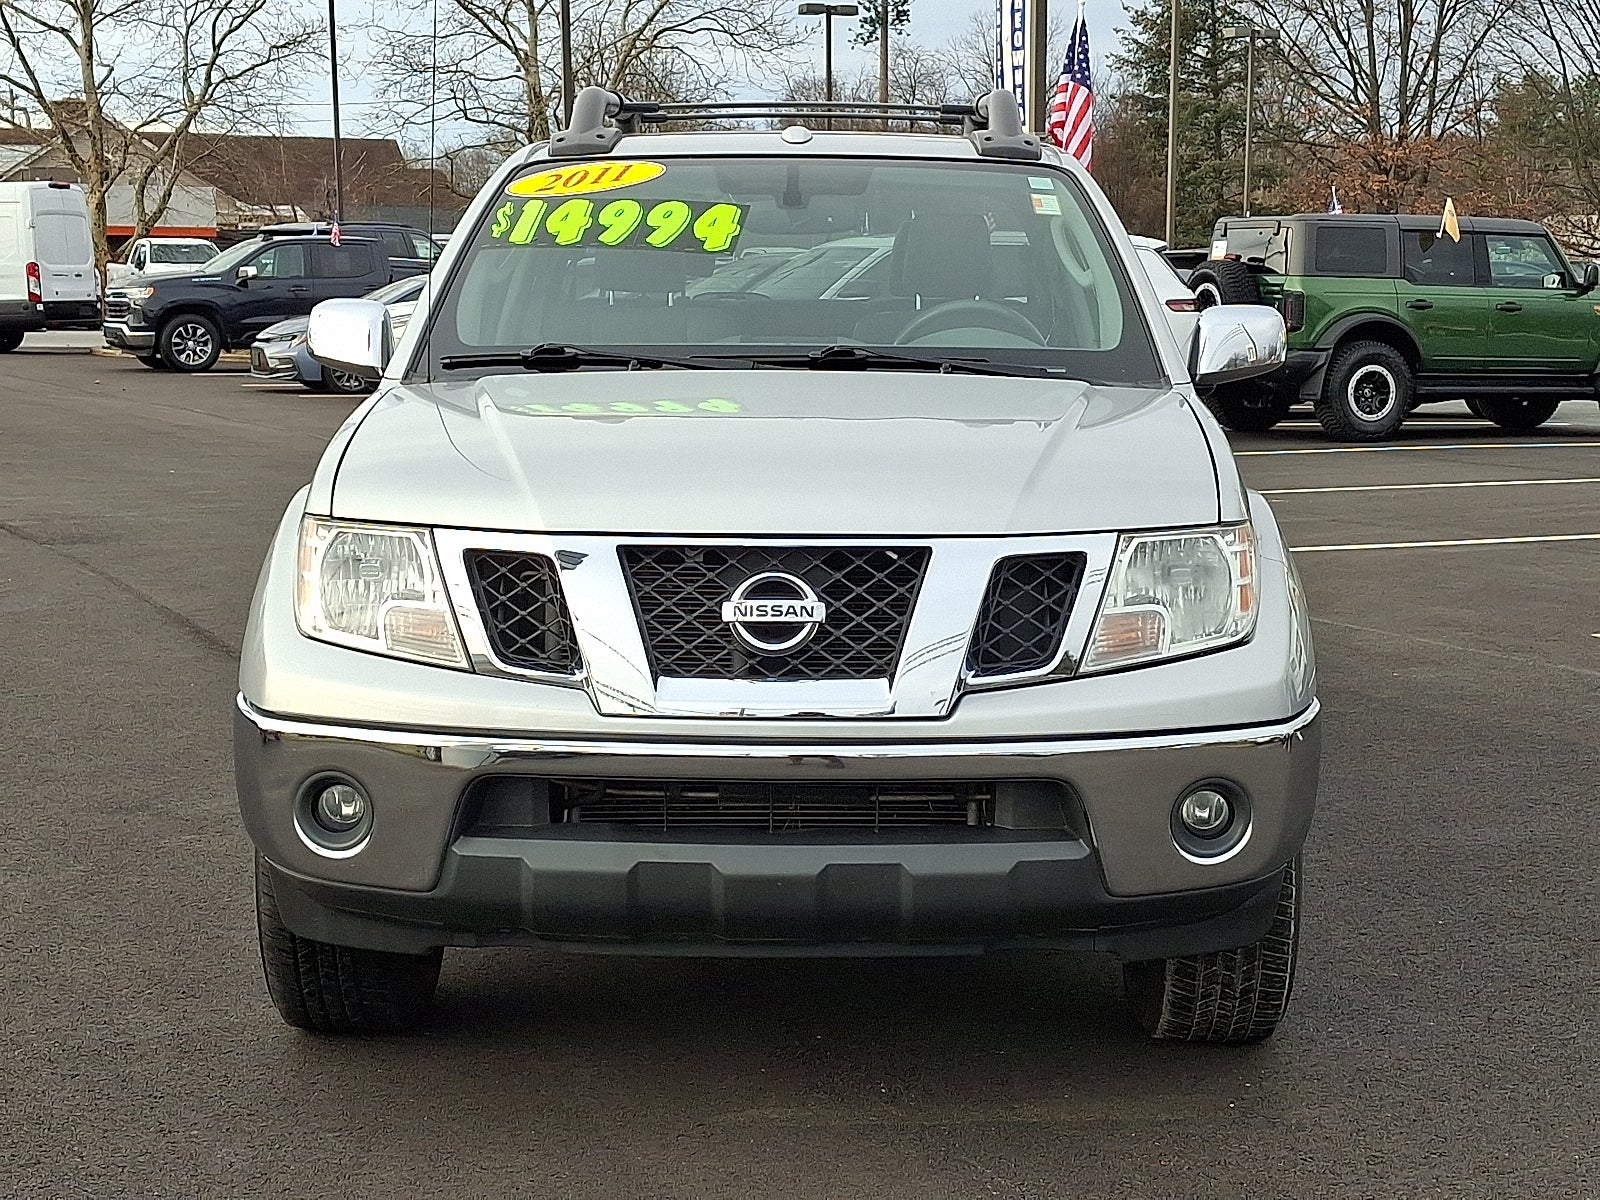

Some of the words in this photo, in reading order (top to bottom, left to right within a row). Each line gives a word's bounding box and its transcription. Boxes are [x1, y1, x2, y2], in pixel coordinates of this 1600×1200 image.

[534, 164, 634, 193] 2011
[491, 197, 742, 253] $14994
[733, 604, 815, 618] NISSAN
